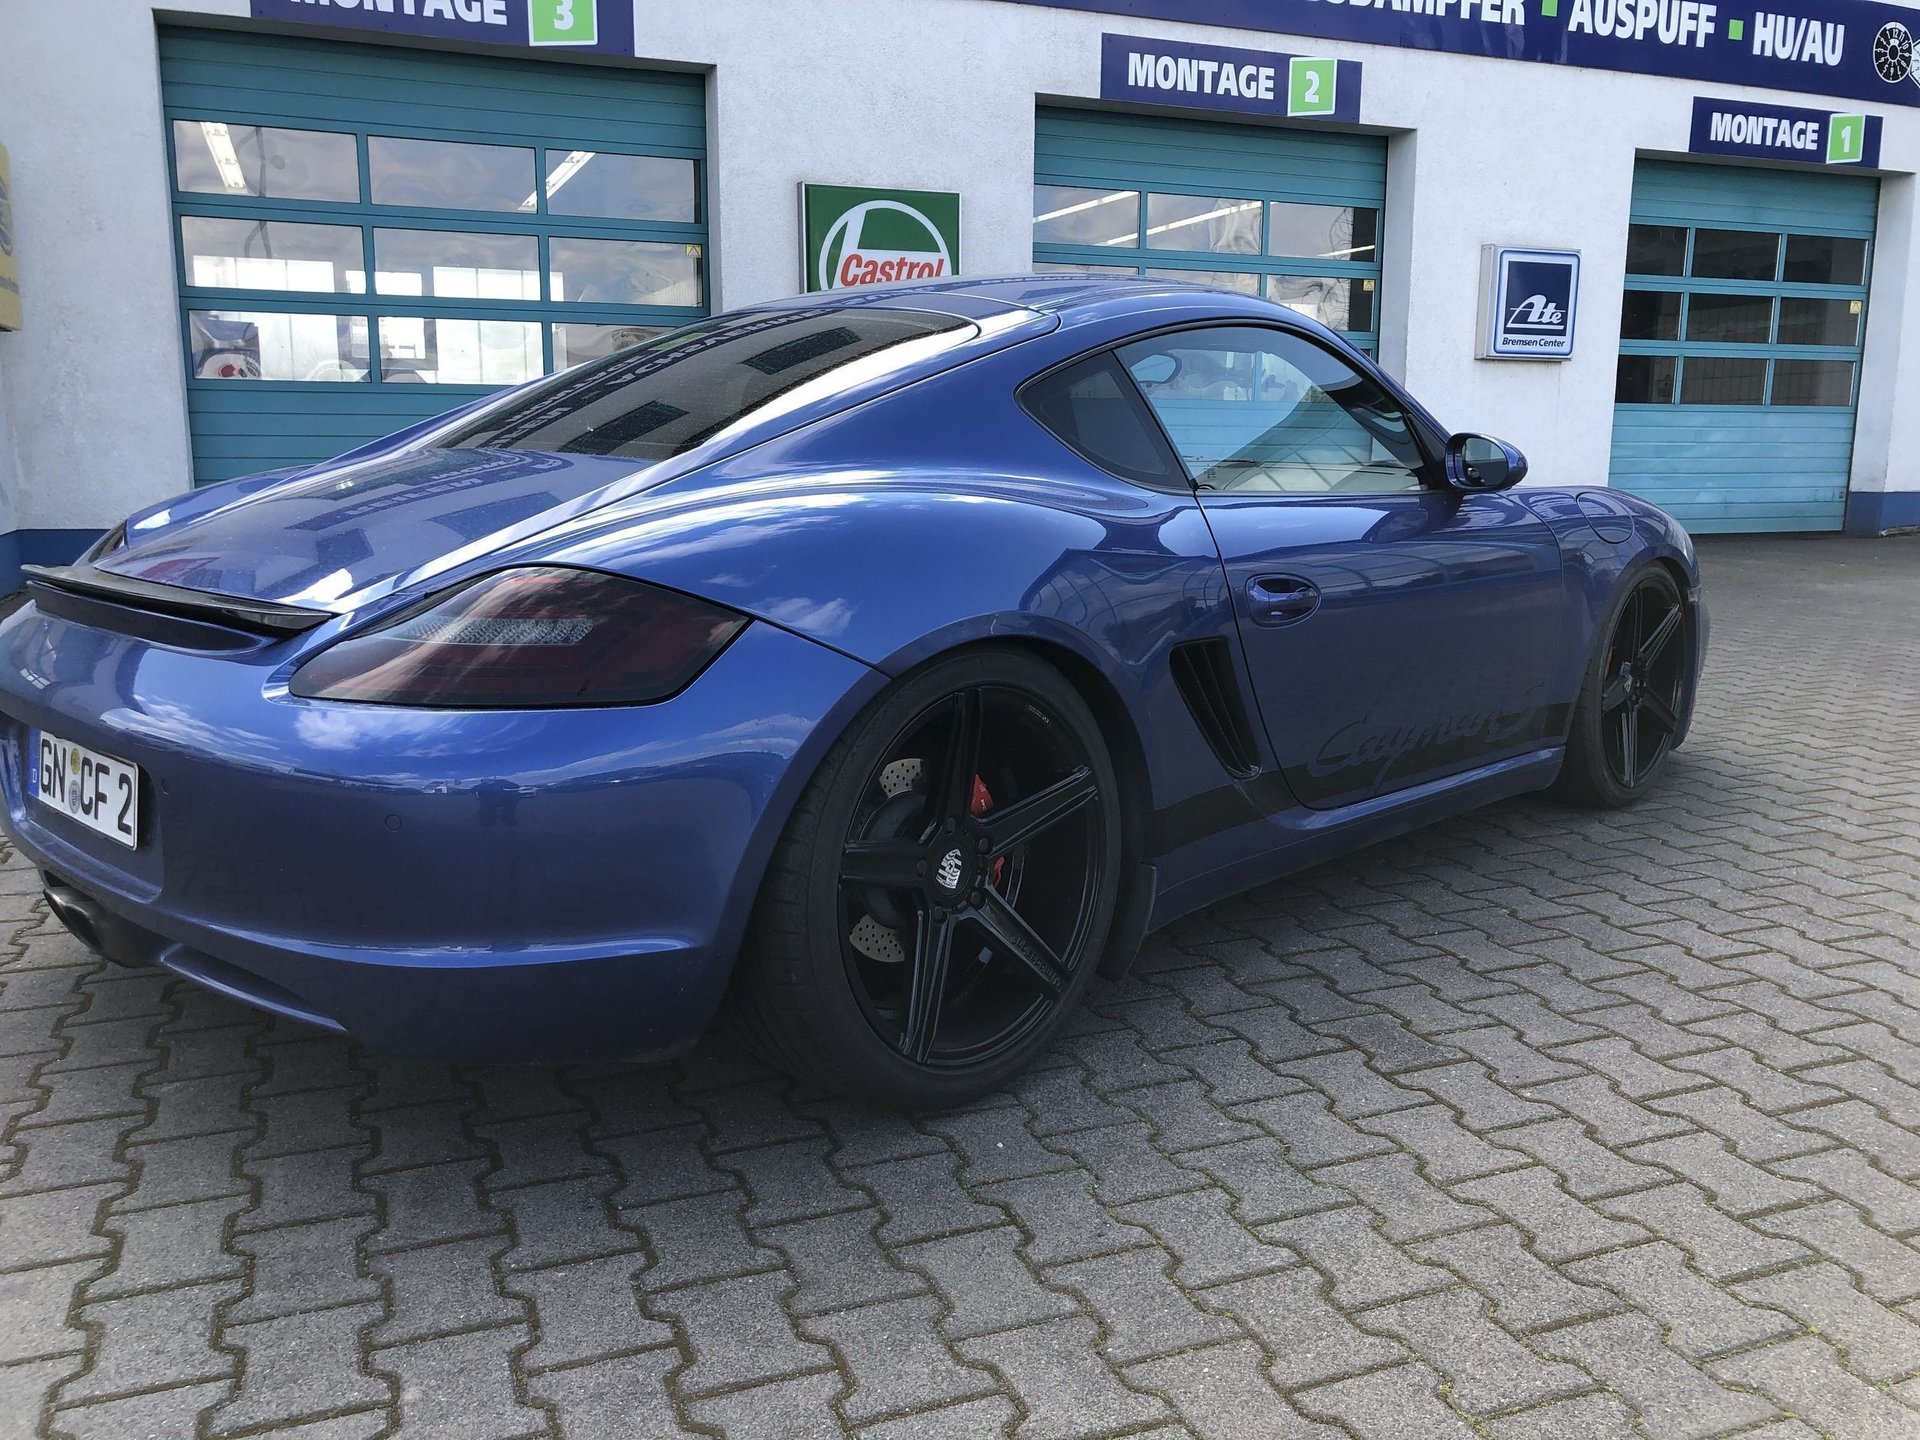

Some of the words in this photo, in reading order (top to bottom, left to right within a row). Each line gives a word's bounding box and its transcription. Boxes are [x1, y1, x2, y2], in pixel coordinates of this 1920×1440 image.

[553, 0, 574, 30] 3
[1568, 0, 1717, 48] AUSPUFF
[1752, 12, 1846, 66] HU/AU
[1128, 52, 1275, 100] MONTAGE
[1304, 71, 1320, 103] 2
[1710, 112, 1819, 150] MONTAGE
[1841, 126, 1852, 153] 1
[840, 253, 944, 287] Castrol
[1502, 337, 1538, 346] Bremsen
[1539, 338, 1566, 347] Center
[32, 768, 37, 783] D
[40, 738, 67, 803] GN
[80, 756, 110, 820] CF
[117, 772, 133, 836] 2
